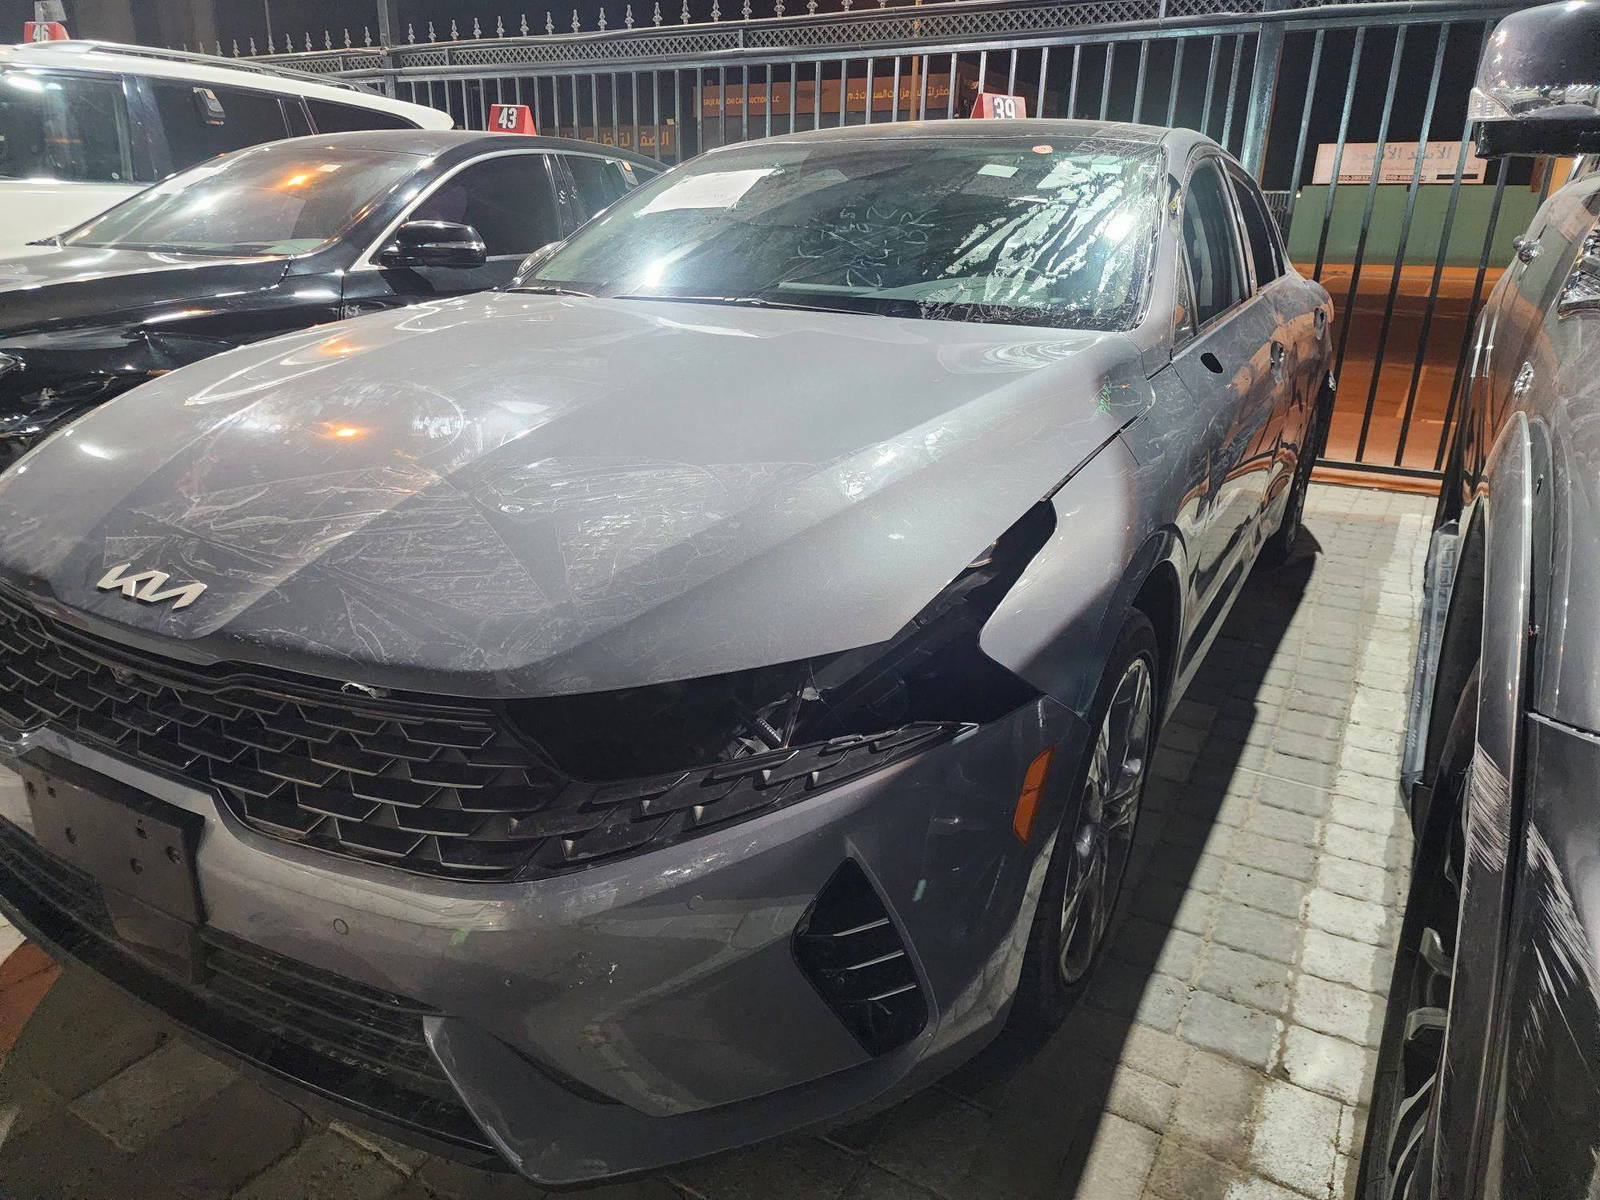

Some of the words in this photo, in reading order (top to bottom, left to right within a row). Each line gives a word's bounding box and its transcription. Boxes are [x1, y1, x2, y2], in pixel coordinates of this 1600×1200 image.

[33, 24, 49, 42] 46
[498, 107, 518, 129] 43
[993, 97, 1016, 120] 39
[97, 563, 207, 609] KIA
